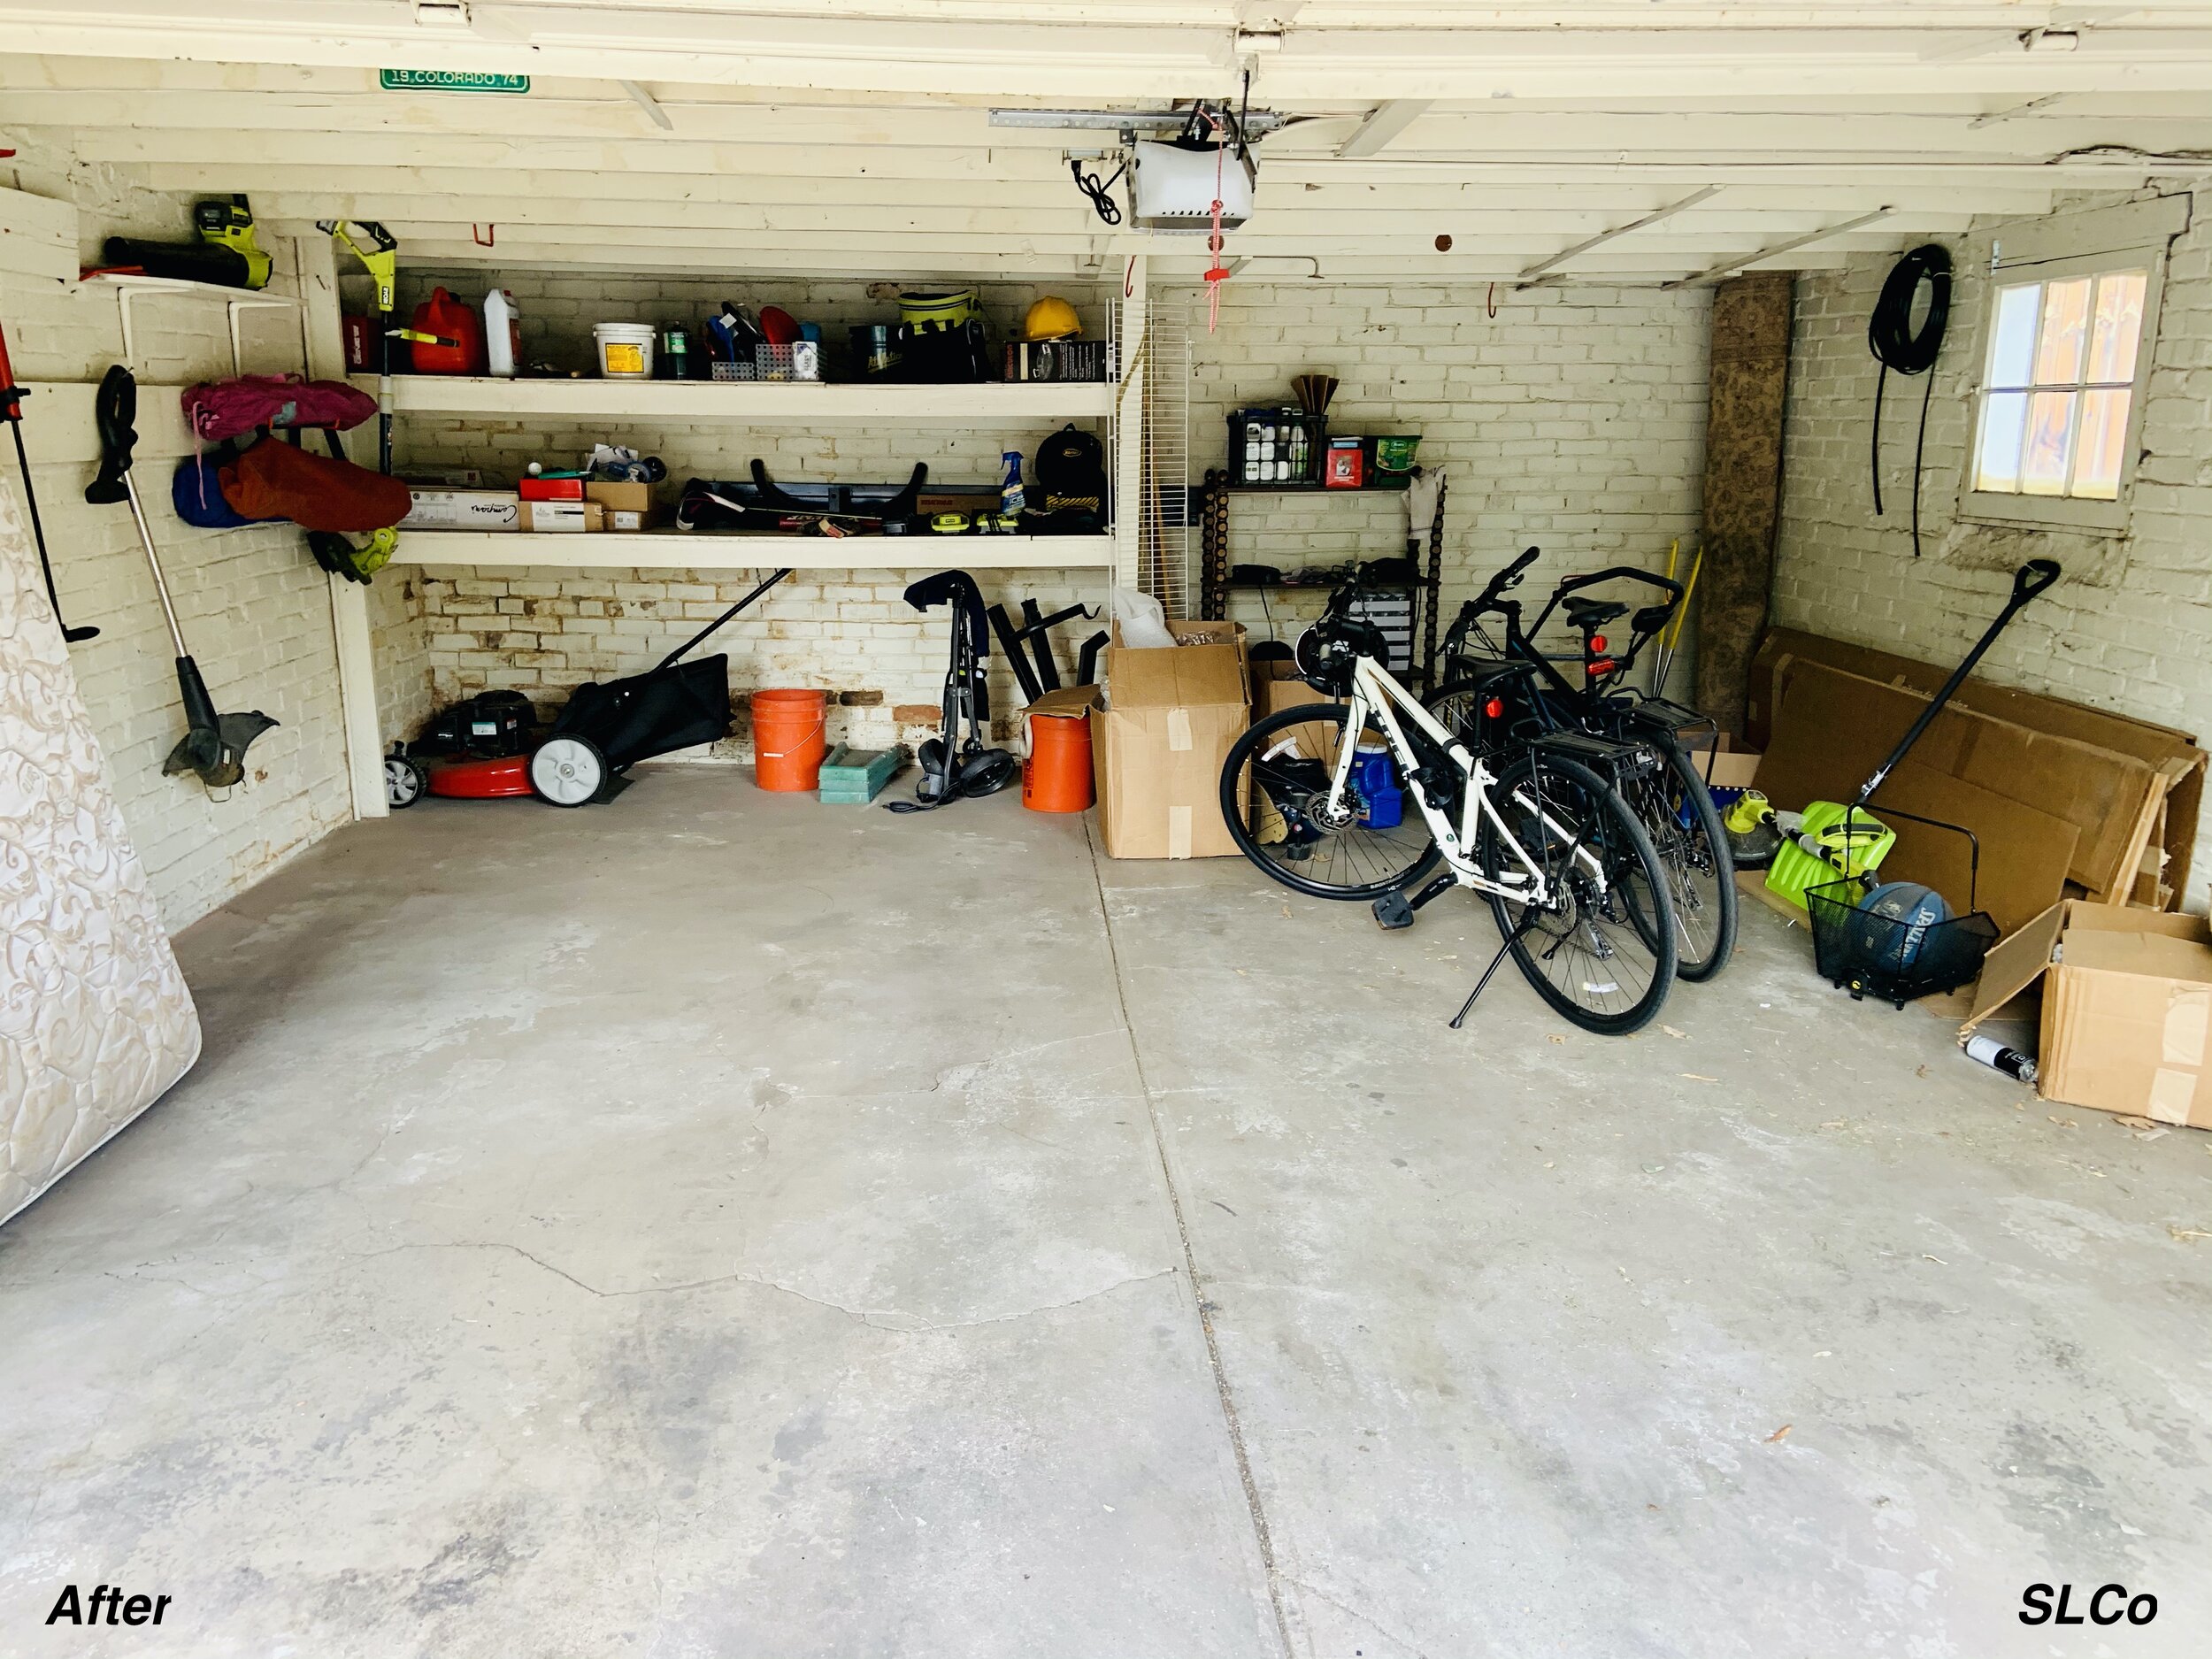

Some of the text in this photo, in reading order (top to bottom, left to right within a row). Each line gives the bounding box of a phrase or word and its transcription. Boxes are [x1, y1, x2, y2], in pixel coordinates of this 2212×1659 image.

[392, 70, 518, 86] 19 COLORADO 74
